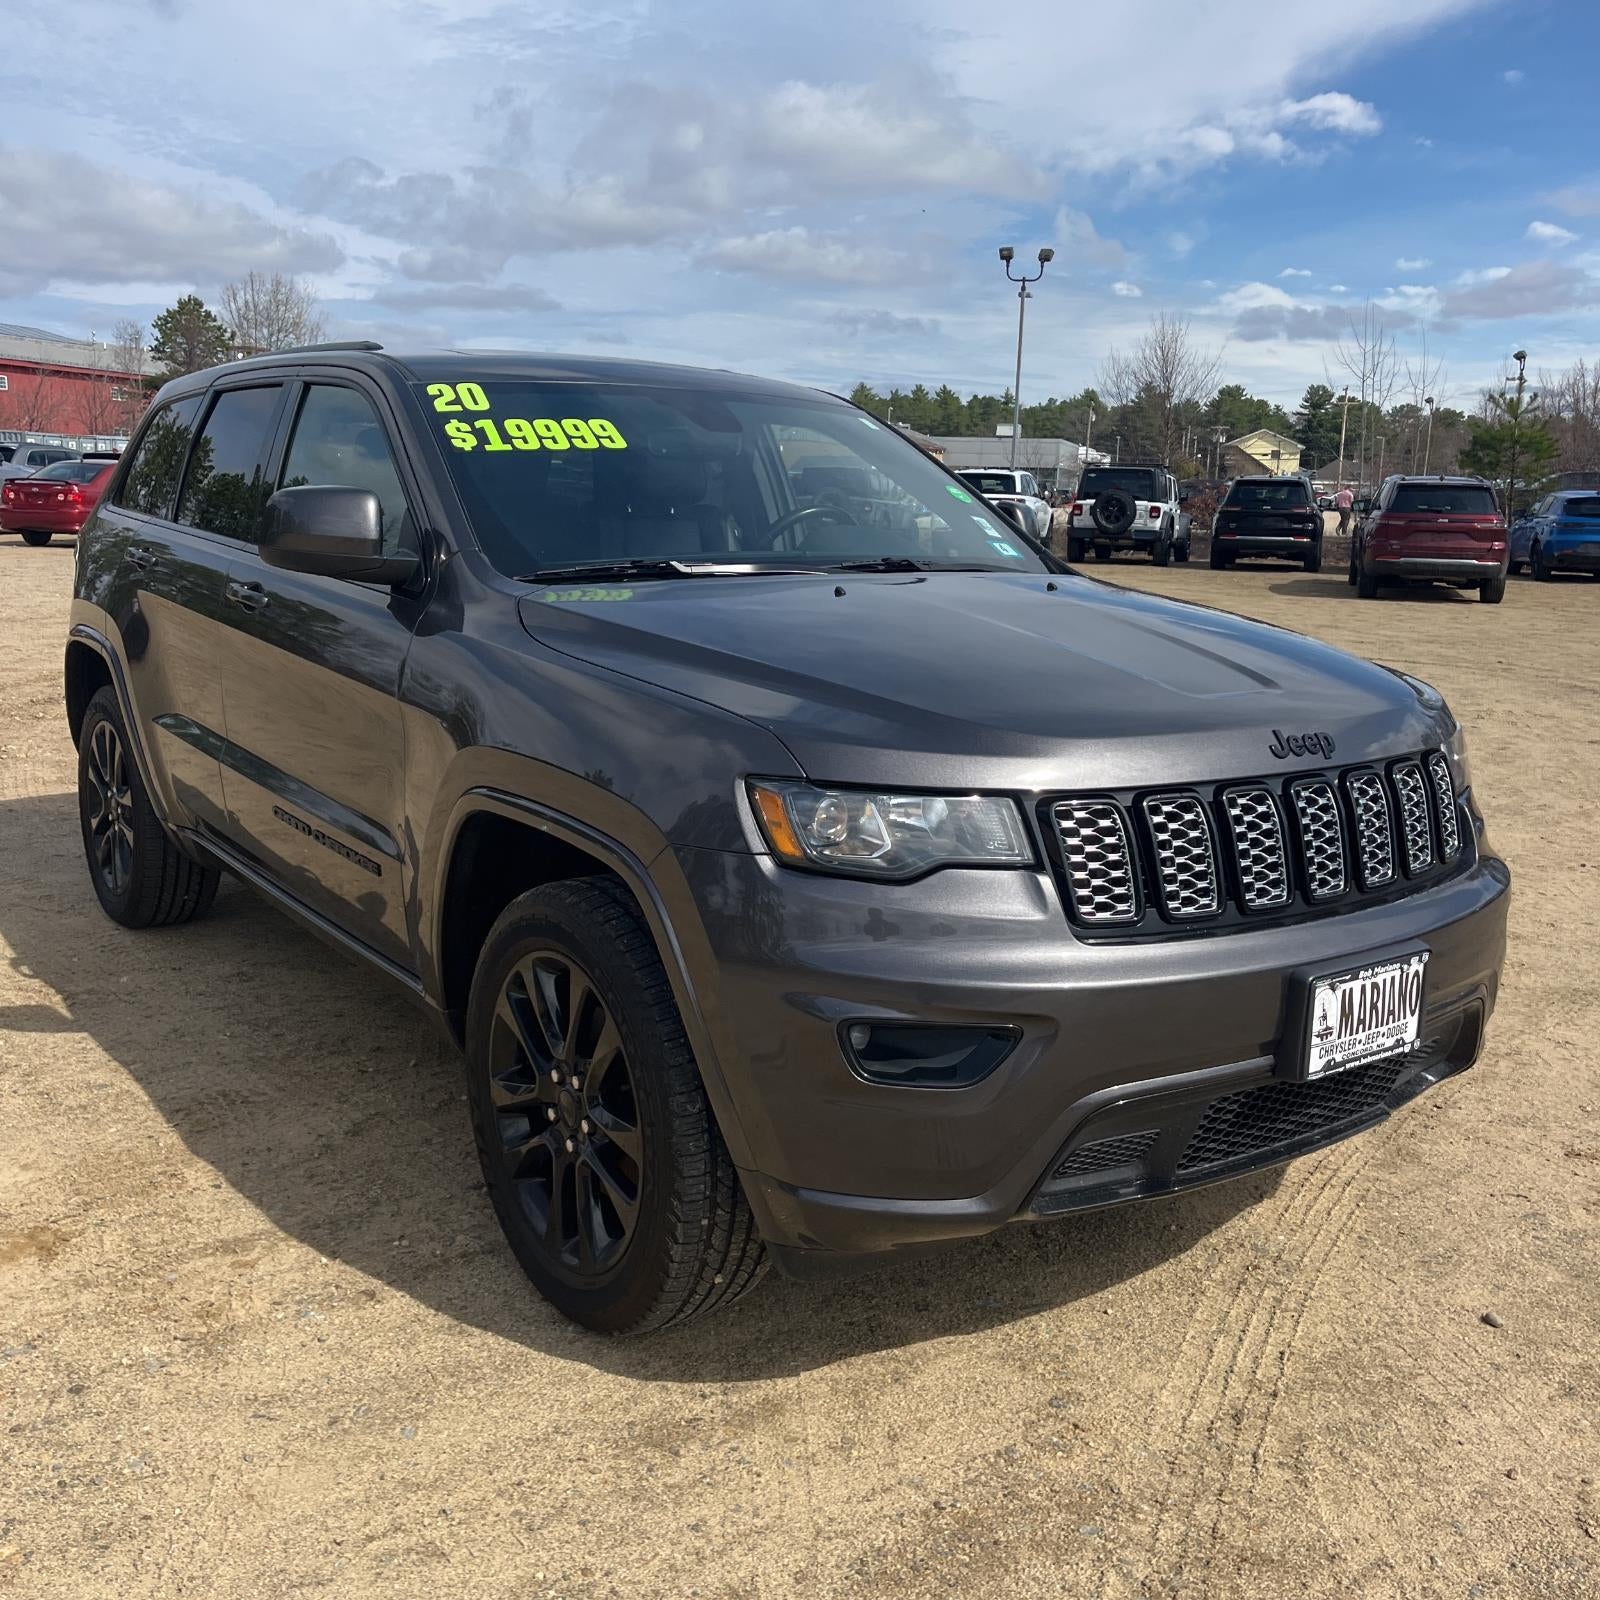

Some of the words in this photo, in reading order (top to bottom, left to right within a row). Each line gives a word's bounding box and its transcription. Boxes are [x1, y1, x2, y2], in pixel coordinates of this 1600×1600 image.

[426, 382, 490, 412] 20
[444, 418, 628, 451] $19999
[1268, 729, 1336, 760] Jeep
[1337, 968, 1421, 1041] MARIANO
[1318, 1037, 1357, 1060] CHRYSLER
[1362, 1031, 1381, 1047] JEEP
[1386, 1021, 1409, 1039] DODGE
[1376, 1041, 1386, 1051] NH
